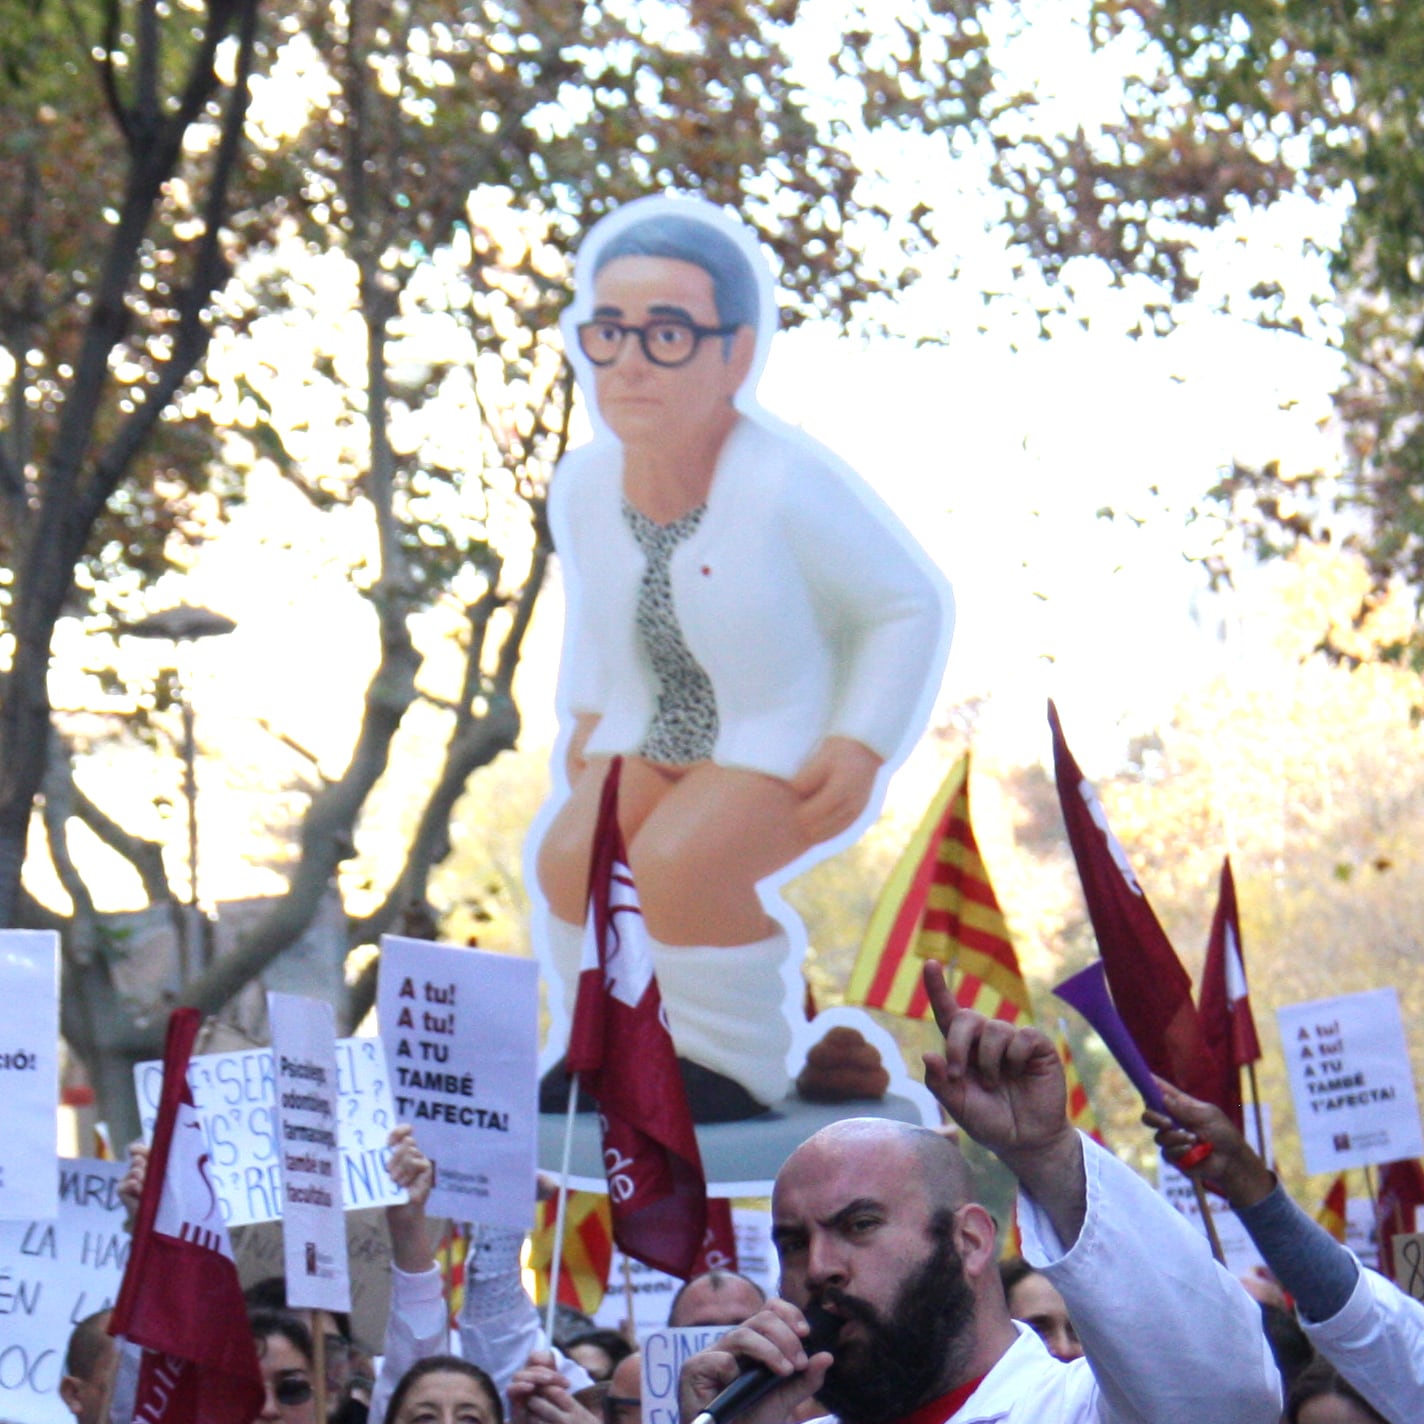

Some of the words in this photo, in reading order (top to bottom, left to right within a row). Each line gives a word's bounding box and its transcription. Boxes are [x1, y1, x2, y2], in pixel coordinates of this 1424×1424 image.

[399, 977, 416, 1000] A
[424, 982, 457, 1006] tu!
[397, 1007, 415, 1030] A
[422, 1012, 456, 1036] tu!
[397, 1039, 413, 1059] A
[419, 1040, 450, 1064] TU
[396, 1066, 475, 1097] TAMBÉ
[394, 1096, 510, 1133] T'AFECTA!
